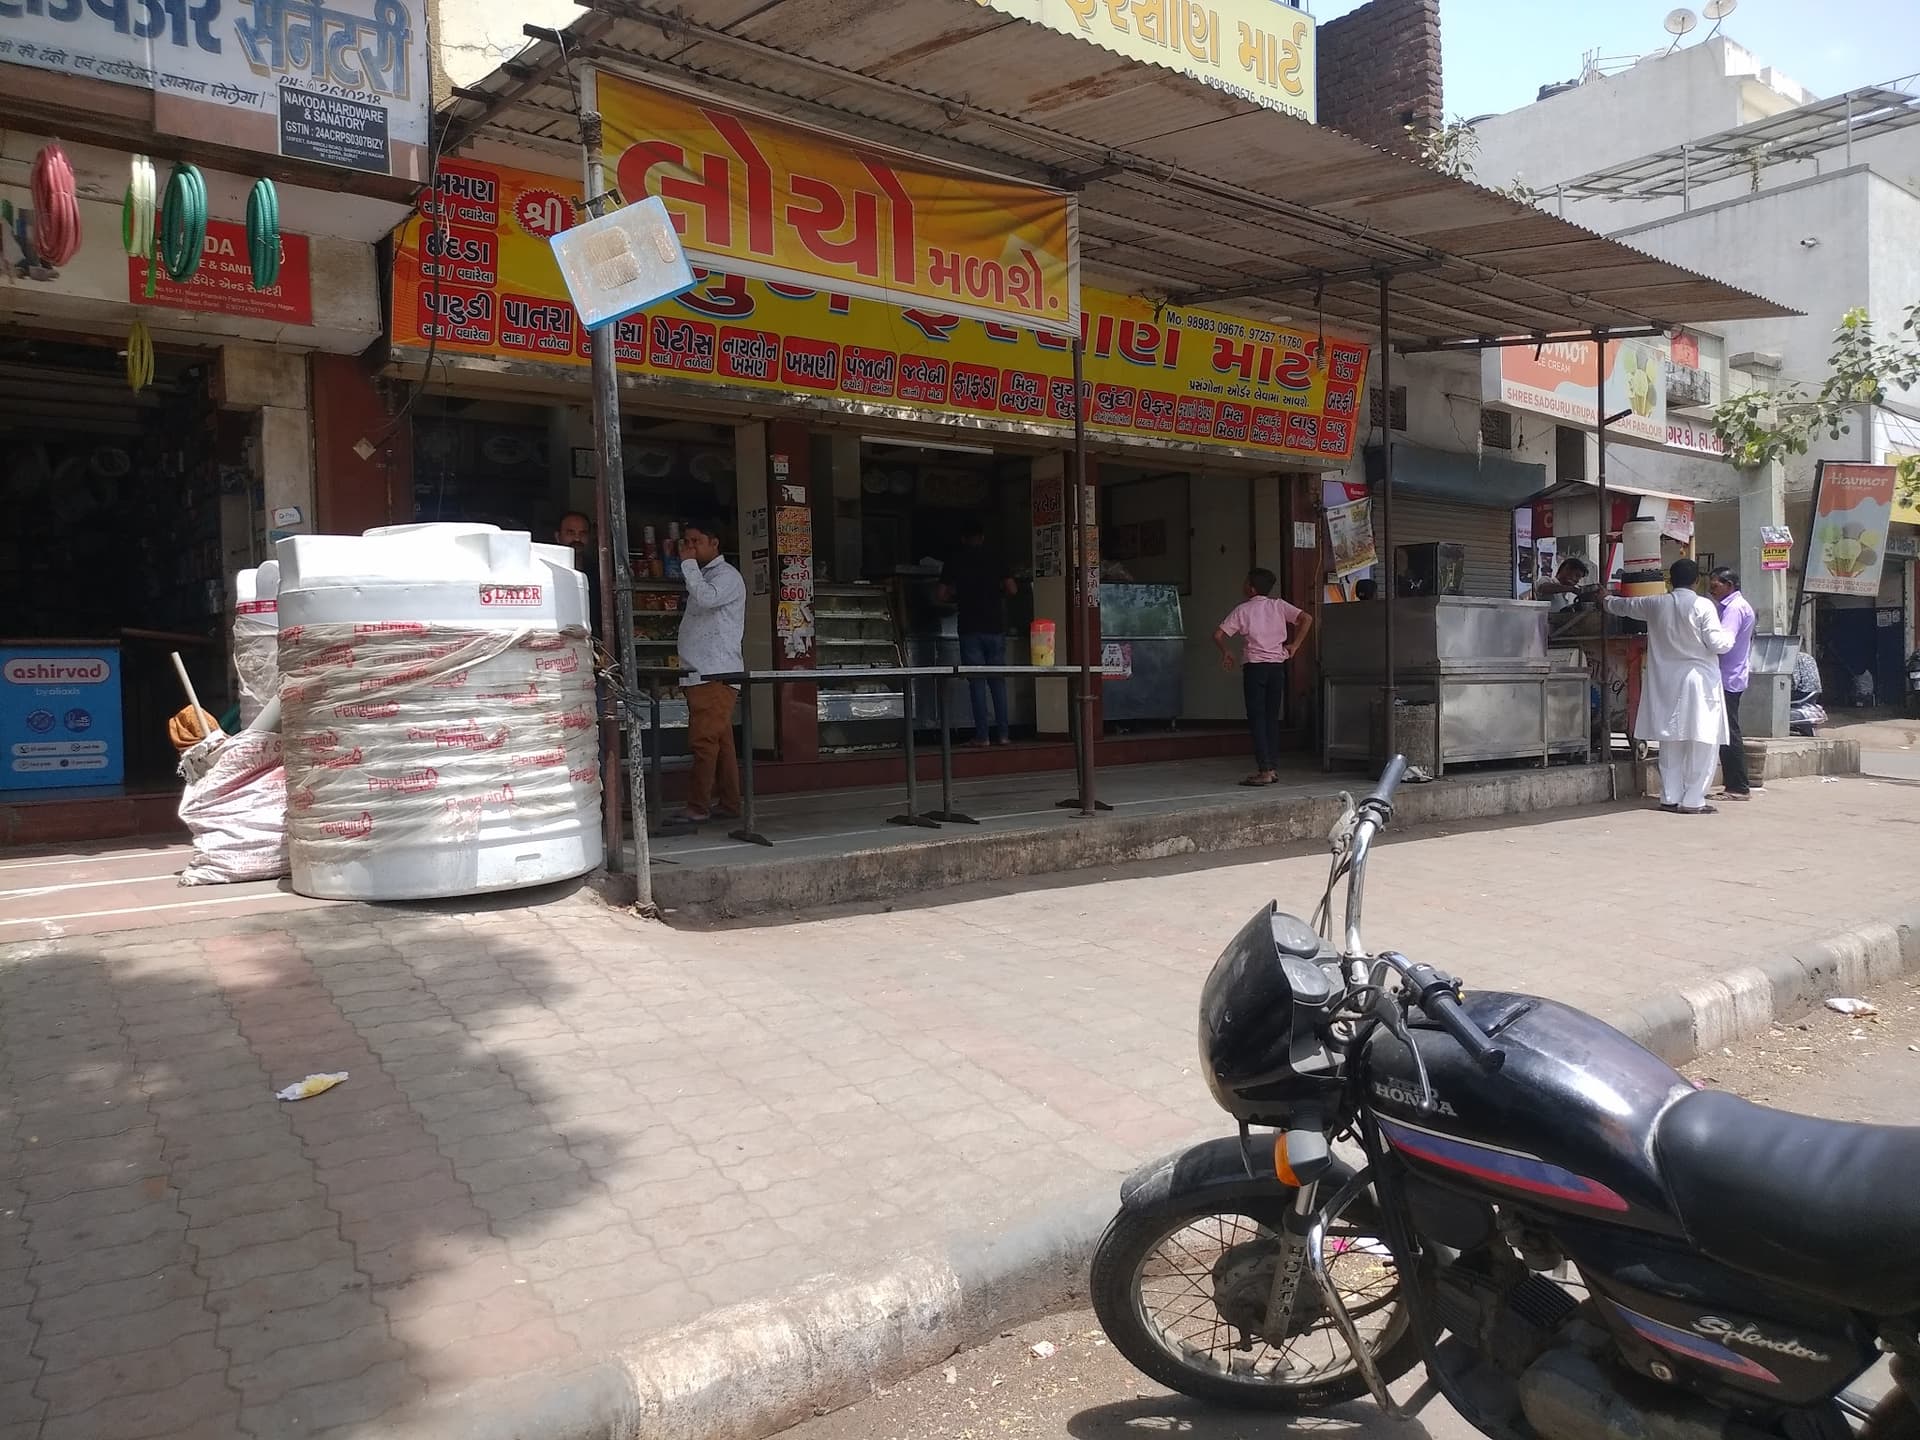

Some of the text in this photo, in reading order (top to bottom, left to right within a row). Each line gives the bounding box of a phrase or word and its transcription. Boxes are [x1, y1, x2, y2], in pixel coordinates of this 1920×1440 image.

[1238, 22, 1307, 96] માર્ટ
[160, 73, 209, 95] सामान
[284, 91, 384, 123] NAKODA HARDWARE
[304, 108, 366, 131] & SANATORY
[285, 121, 310, 135] GSTIN
[523, 197, 563, 233] શ્રી
[617, 106, 916, 286] લોચો
[928, 248, 1058, 312] મળશે.
[208, 261, 217, 271] &
[220, 262, 253, 275] SANIT
[504, 300, 571, 333] પાતરા
[503, 331, 525, 345] સાદા
[538, 335, 569, 350] તળેલા
[653, 318, 713, 357] પેટીસ
[1166, 310, 1184, 327] Mo.
[1187, 313, 1215, 331] 98983
[1249, 329, 1275, 344] 97257
[1278, 334, 1302, 350] 11760
[722, 332, 777, 361] નાયલોન
[730, 355, 768, 378] ખમણ
[785, 347, 837, 380] ખમણી
[846, 348, 894, 383] પંજાબી
[902, 360, 946, 386] જલેબી
[1548, 359, 1571, 374] CREAM
[953, 372, 997, 403] ફાફડા
[1098, 386, 1134, 412] બુંદી
[1140, 391, 1175, 418] વેફર
[1327, 388, 1355, 416] બરફી
[1506, 387, 1533, 406] SHREE
[1534, 394, 1571, 413] SADGURU
[1571, 402, 1596, 421] KRUPA
[1633, 418, 1664, 437] PARLOUR
[1289, 414, 1318, 438] લાડુ
[1829, 471, 1888, 488] Havmor
[783, 554, 808, 569] કાજુ
[482, 587, 540, 603] 3 LAYER
[13, 664, 102, 679] ashirvad
[536, 653, 574, 672] Penguin
[1691, 1315, 1830, 1362] Splendor
